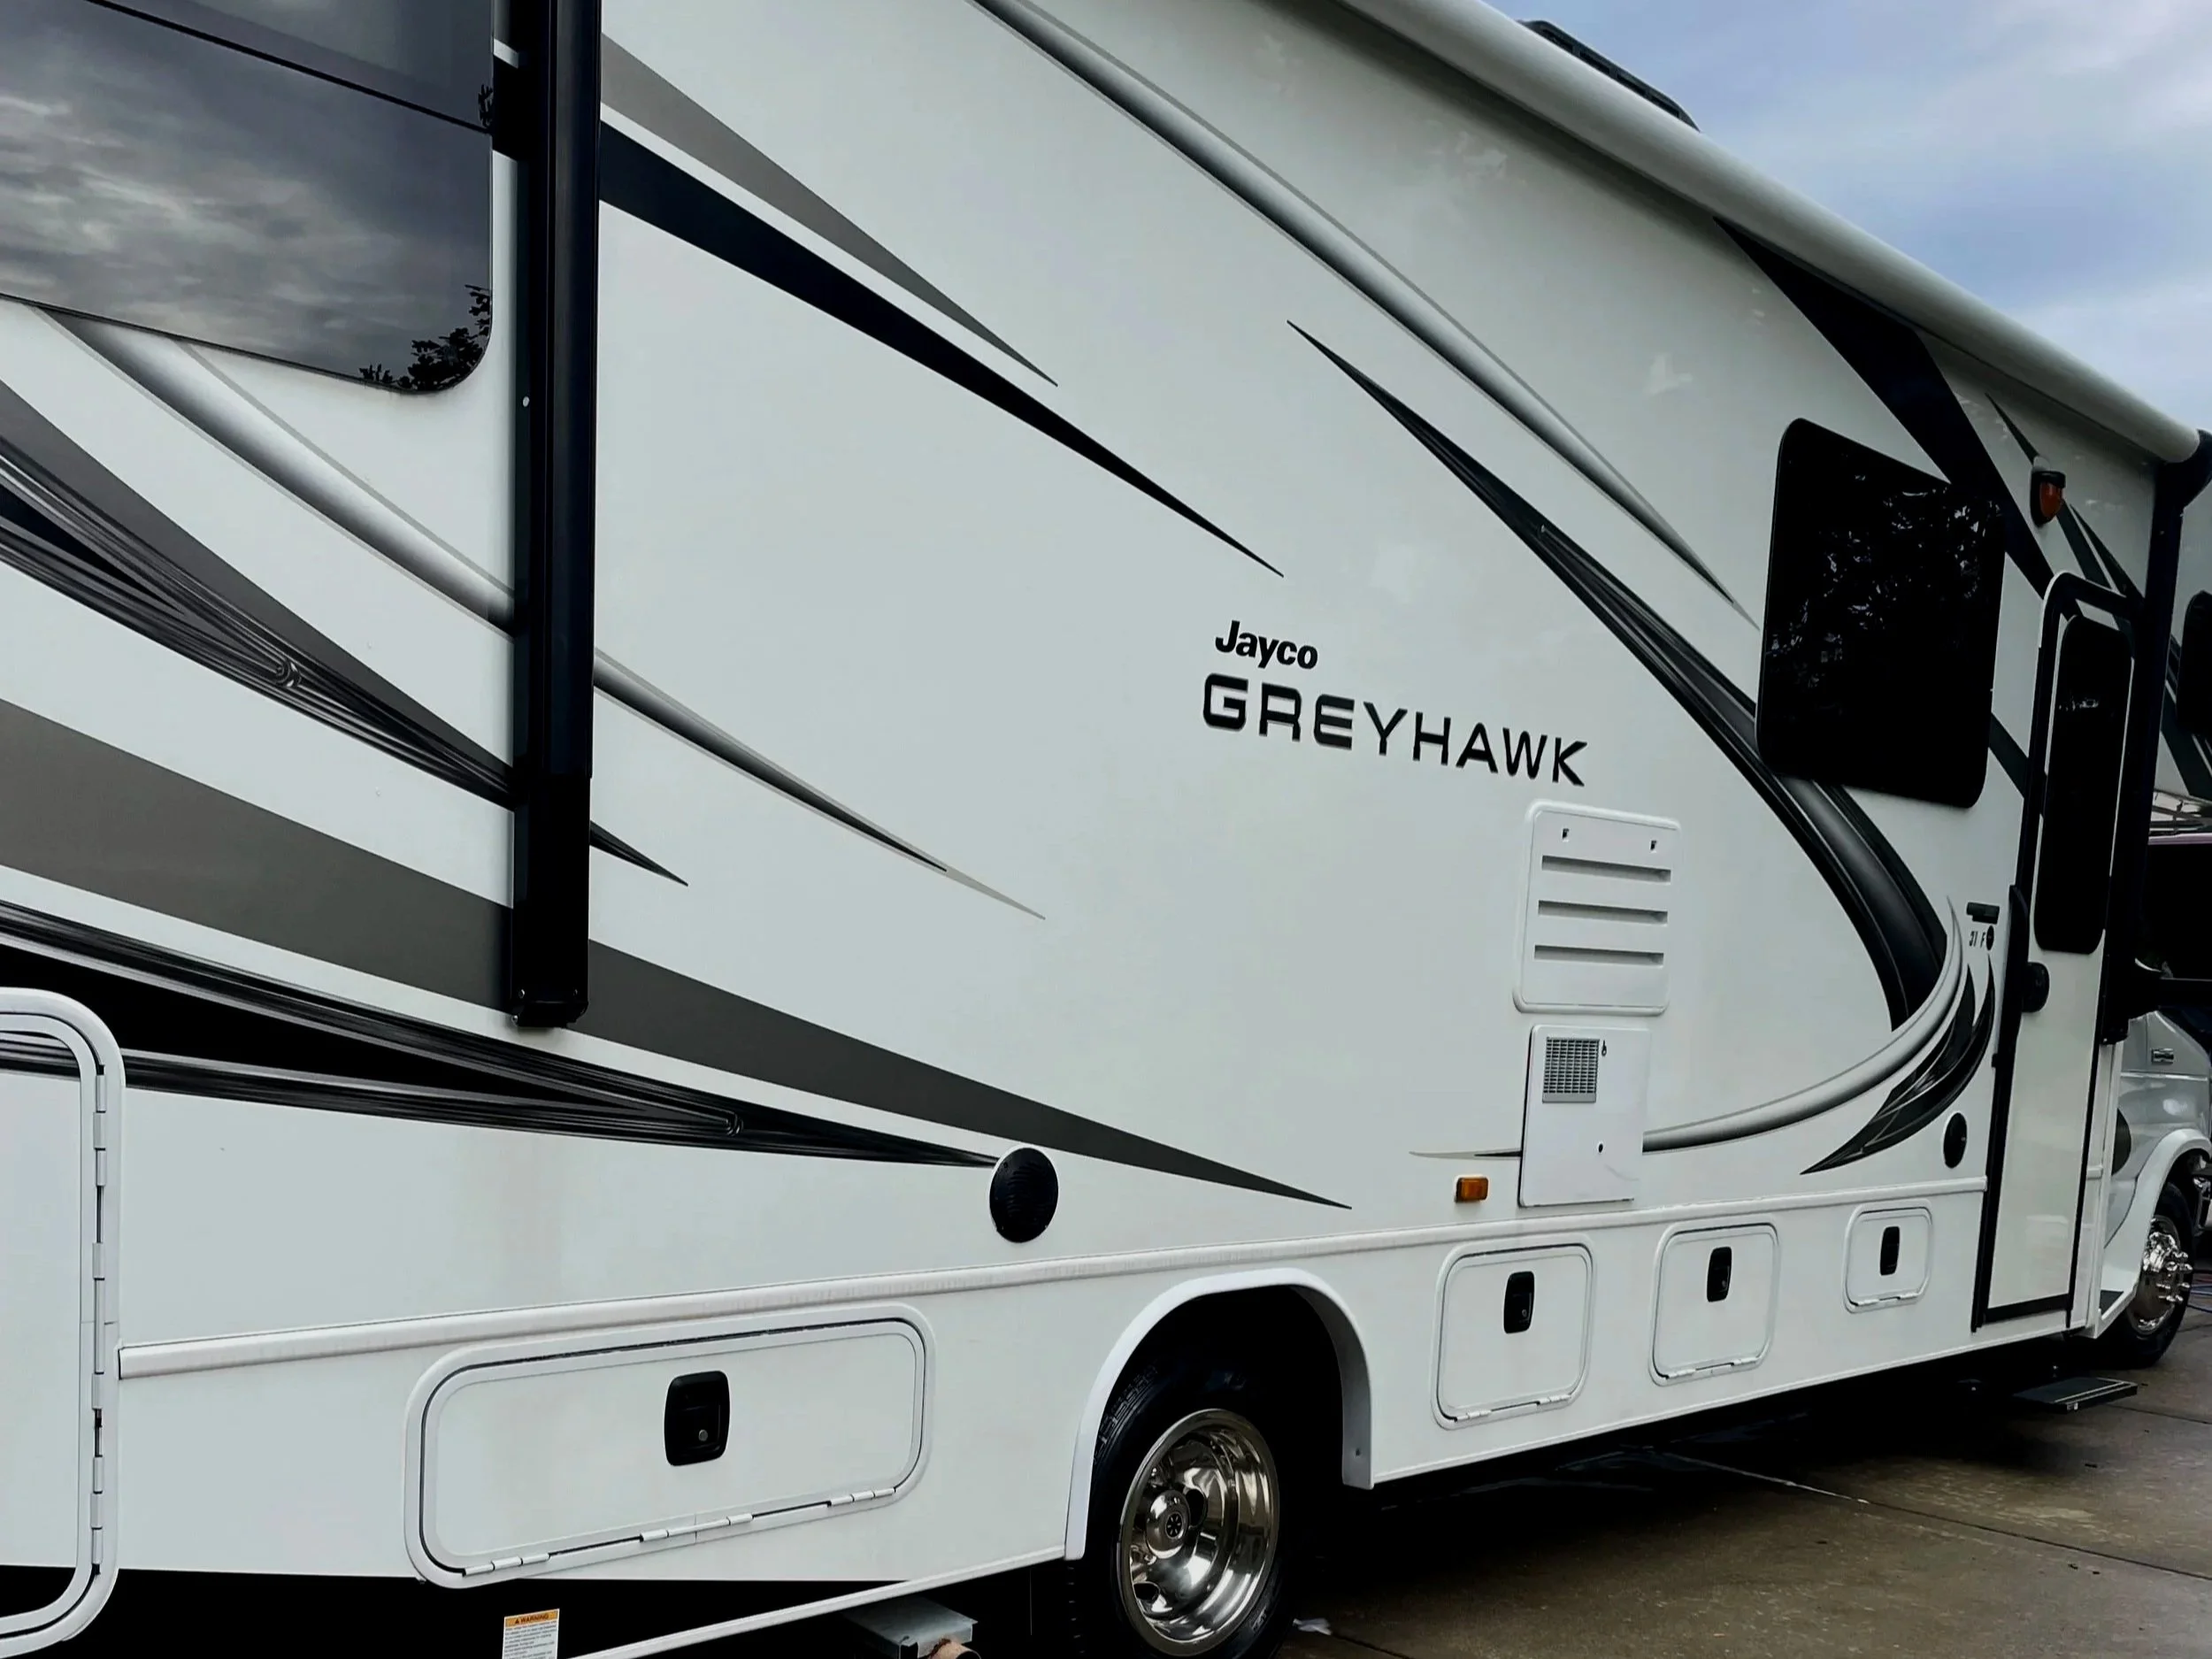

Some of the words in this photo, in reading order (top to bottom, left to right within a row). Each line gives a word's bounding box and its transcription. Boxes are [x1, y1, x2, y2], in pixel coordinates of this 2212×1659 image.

[1215, 619, 1318, 670] Jayco
[1202, 672, 1588, 787] GREYHAWK
[520, 1613, 549, 1623] WARNING
